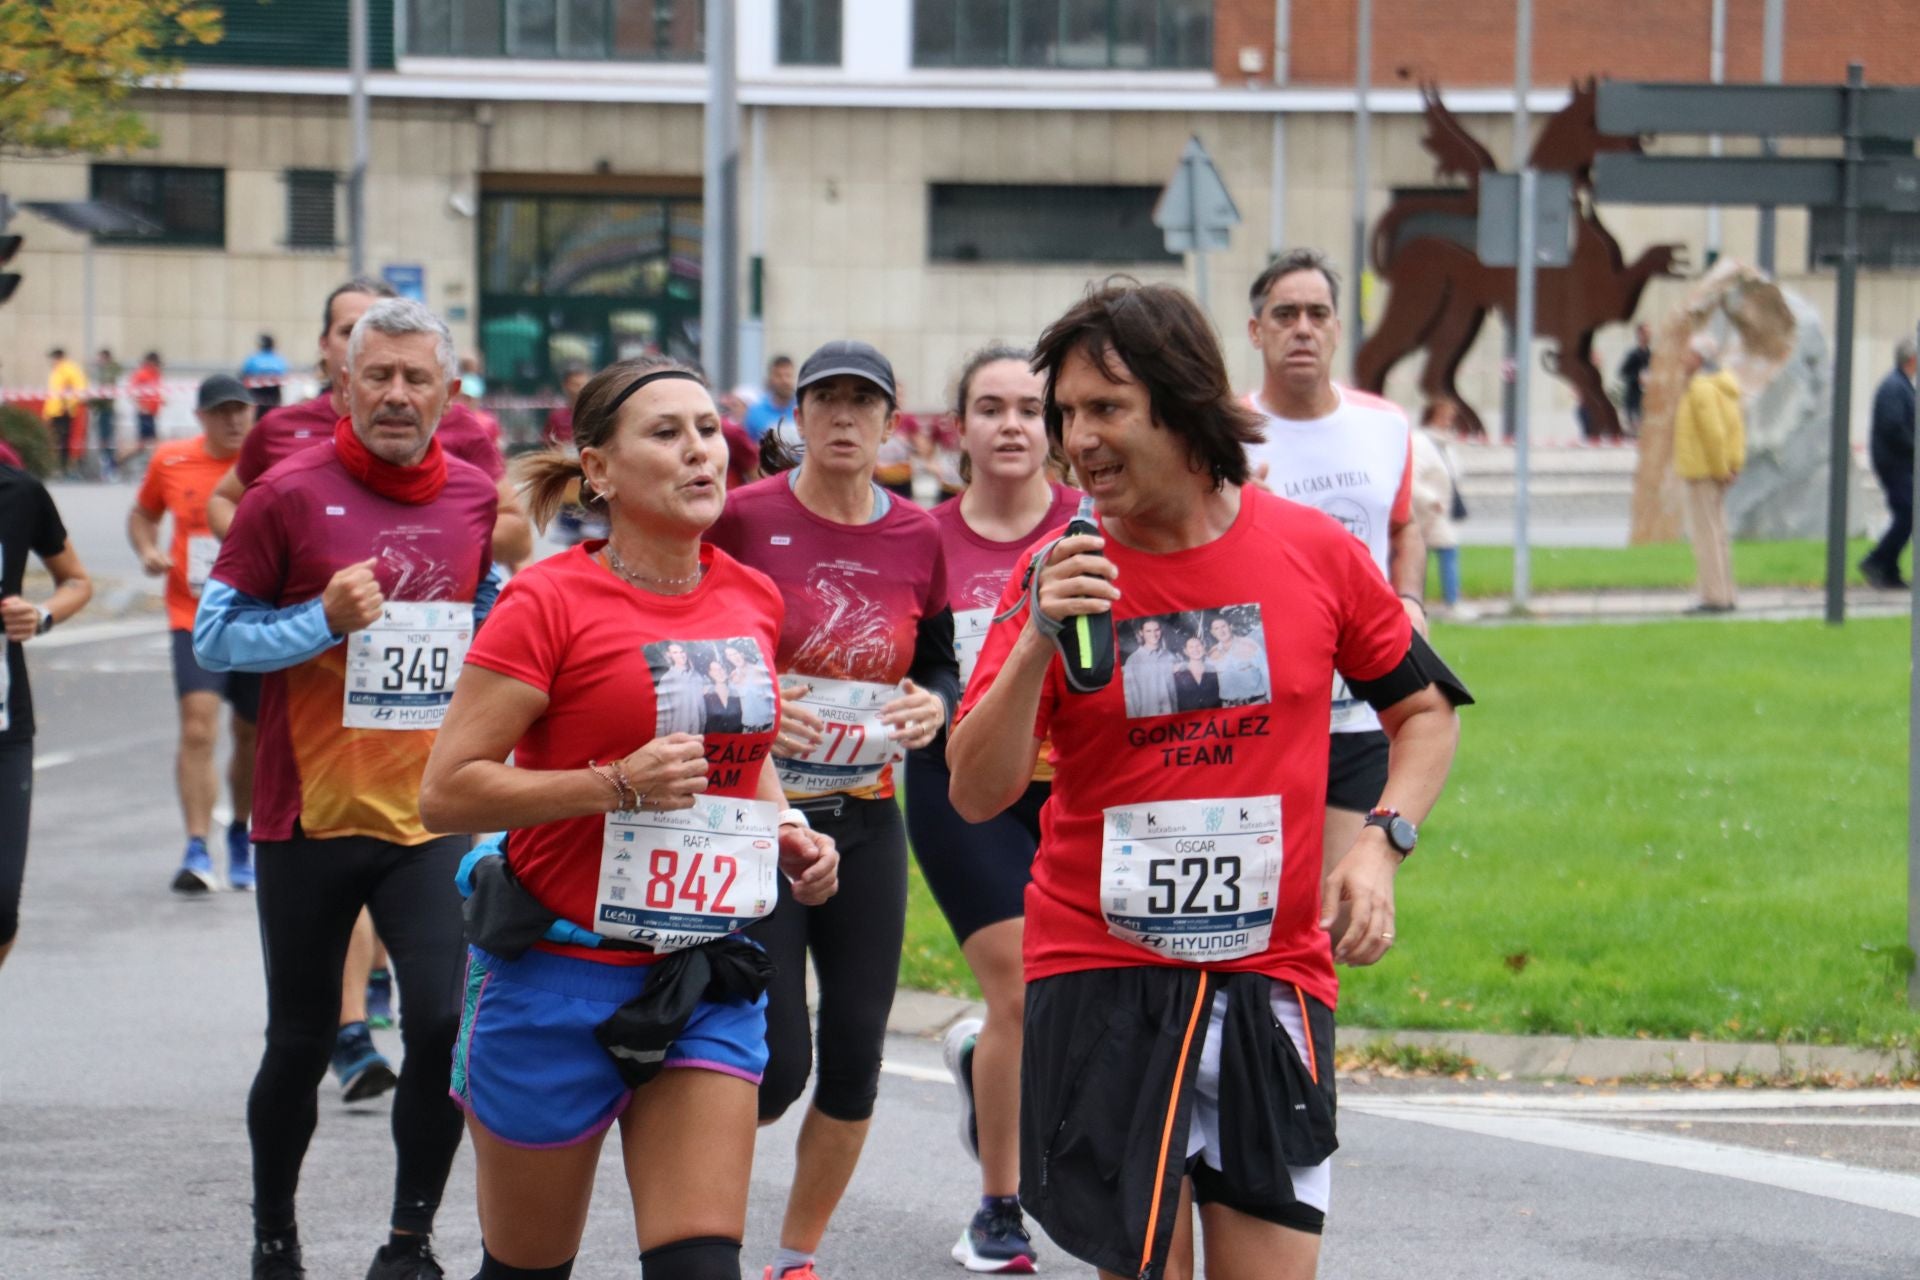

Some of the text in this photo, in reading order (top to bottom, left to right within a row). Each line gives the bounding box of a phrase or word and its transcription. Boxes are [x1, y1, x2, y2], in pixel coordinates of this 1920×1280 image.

[1284, 471, 1371, 498] LA CASA VIEJA
[381, 647, 449, 691] 349
[399, 707, 448, 720] HYUNDA
[817, 707, 857, 721] MARIGEL
[1128, 715, 1271, 748] GONZÁLEZ
[1161, 744, 1234, 768] TEAM
[706, 768, 743, 789] AM
[682, 834, 712, 849] RAFA
[1175, 839, 1216, 854] ÓSCAR
[645, 848, 738, 915] 842
[1147, 855, 1241, 915] 523
[1172, 932, 1249, 950] HYUNDAI
